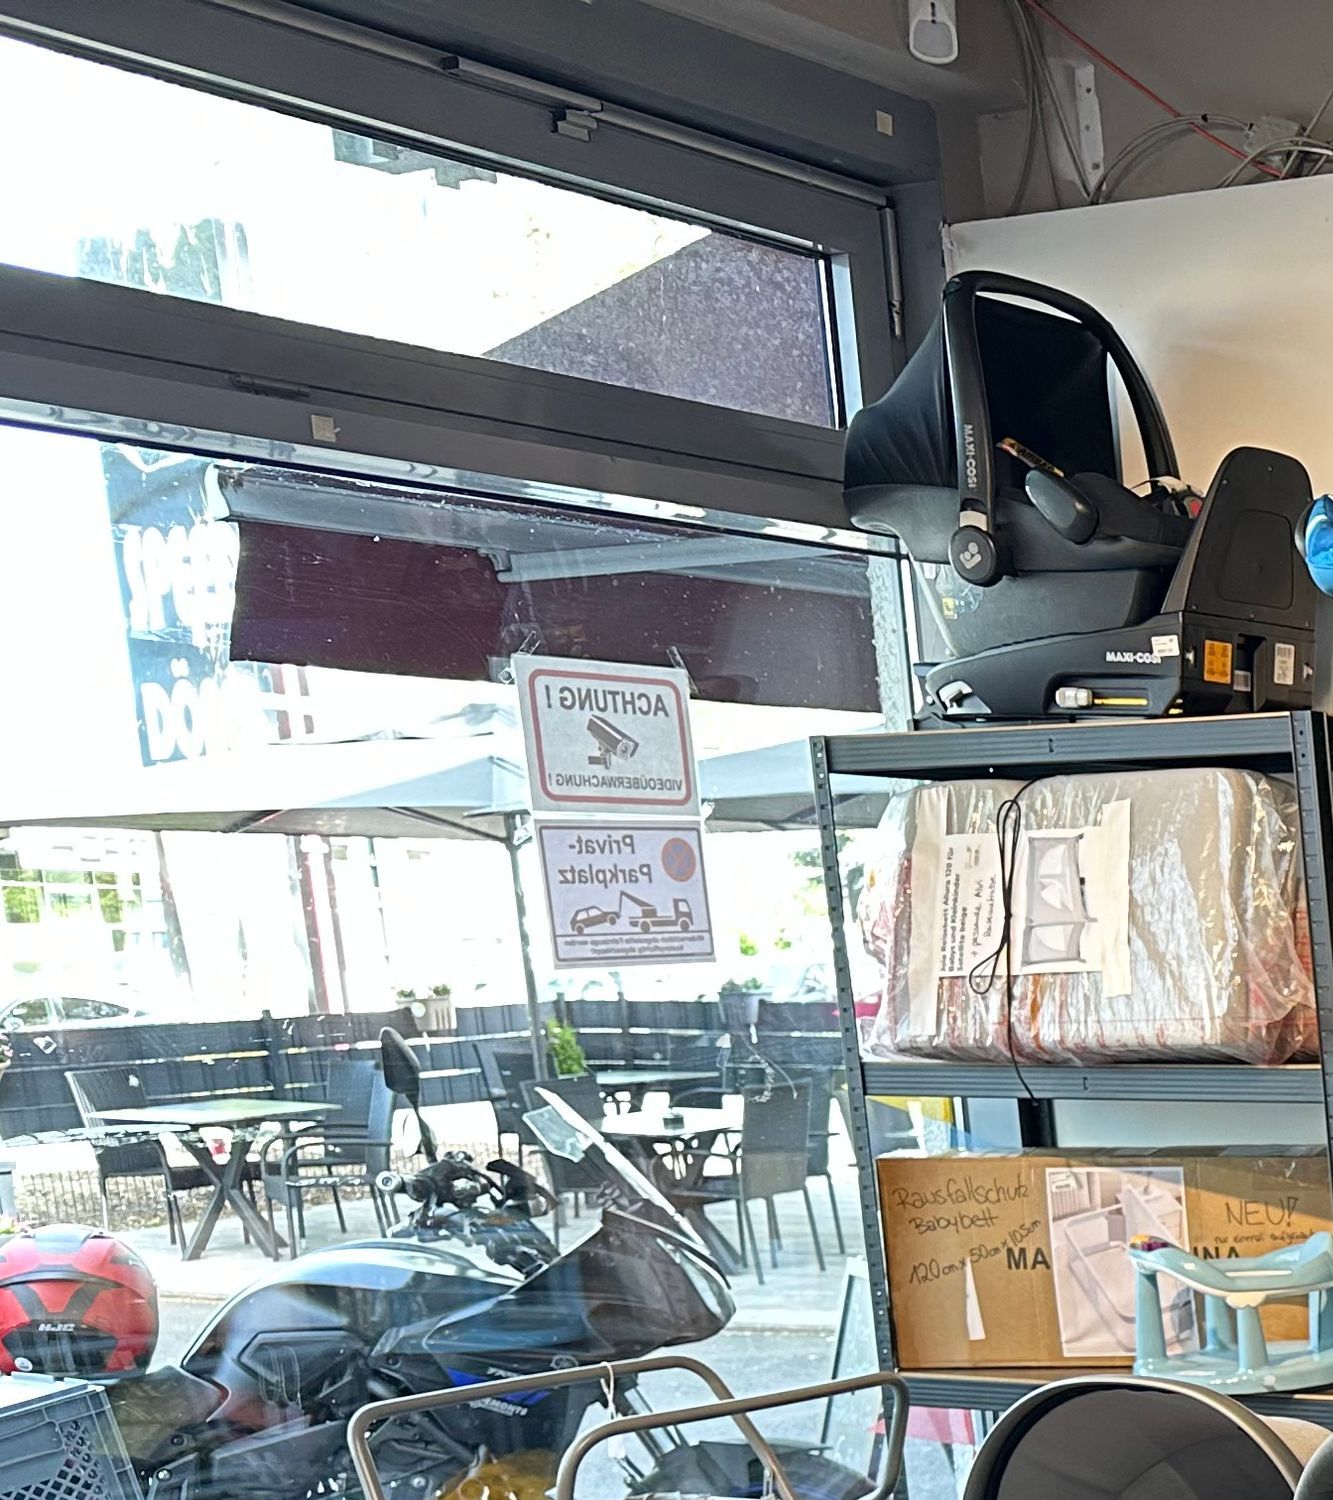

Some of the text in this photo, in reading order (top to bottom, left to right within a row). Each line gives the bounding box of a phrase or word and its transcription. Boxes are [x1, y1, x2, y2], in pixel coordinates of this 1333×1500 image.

[963, 424, 977, 488] MAXI-COSI
[893, 1173, 1030, 1210] Rausfallschutz
[908, 1206, 1000, 1236] Babybett
[1007, 1247, 1050, 1270] MA
[38, 1323, 76, 1332] HJC
